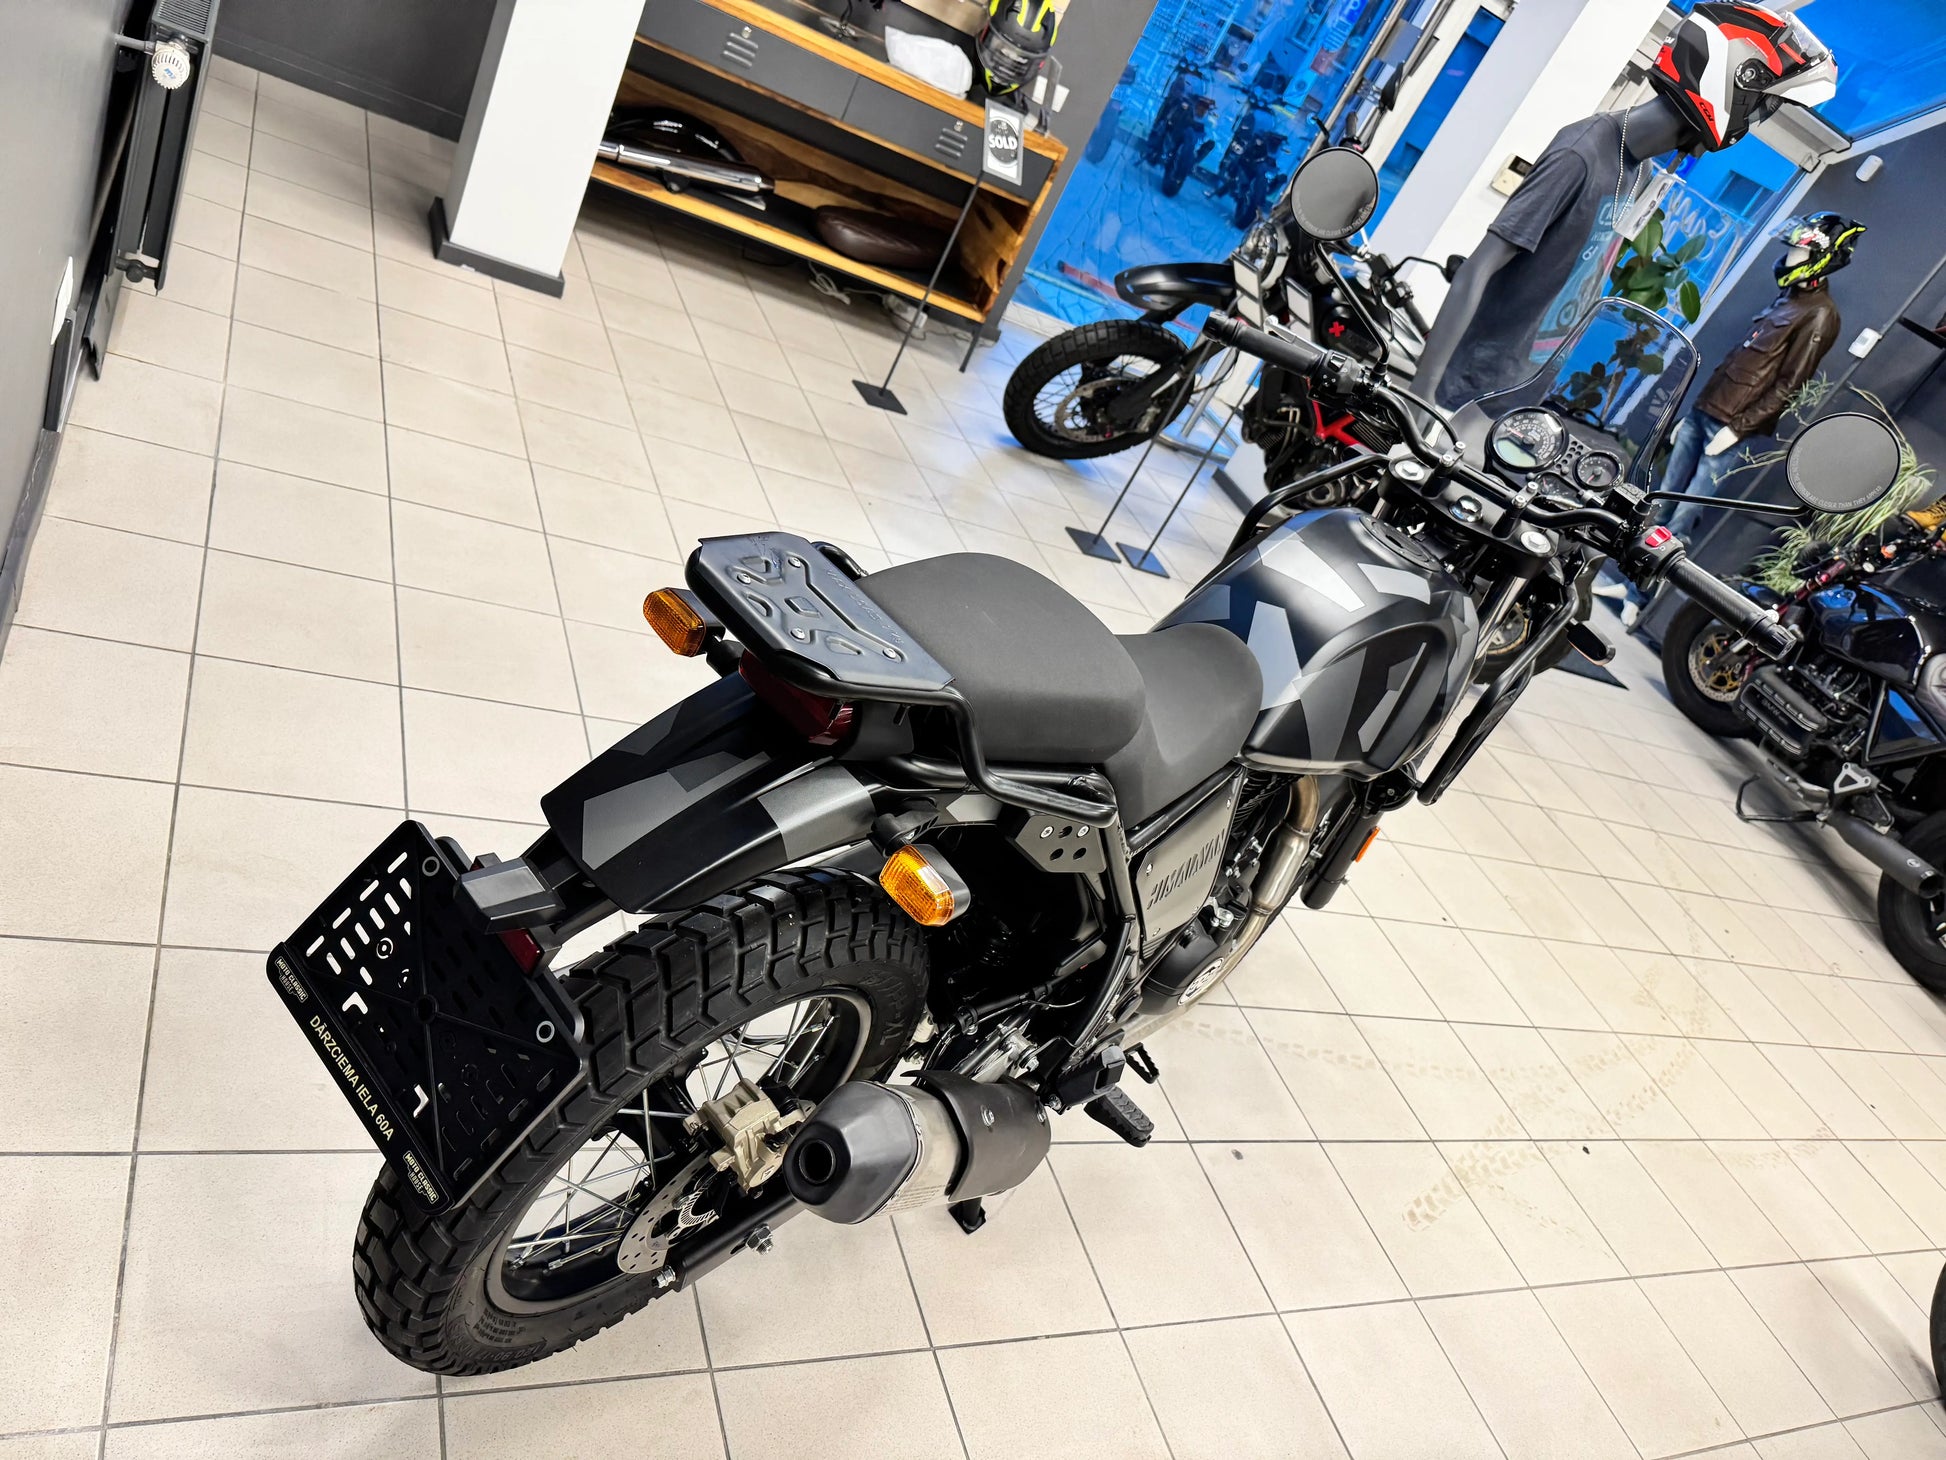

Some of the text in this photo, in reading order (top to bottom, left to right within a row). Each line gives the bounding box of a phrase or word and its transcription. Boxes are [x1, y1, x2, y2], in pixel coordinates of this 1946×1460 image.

[988, 135, 1018, 150] SOLD
[276, 958, 307, 1000] MOTO CLASSIC
[309, 1015, 394, 1141] DĀRZCIEMA IELA 60A
[404, 1152, 437, 1201] MOTO CLASSIC
[409, 1171, 423, 1191] HOUSE
